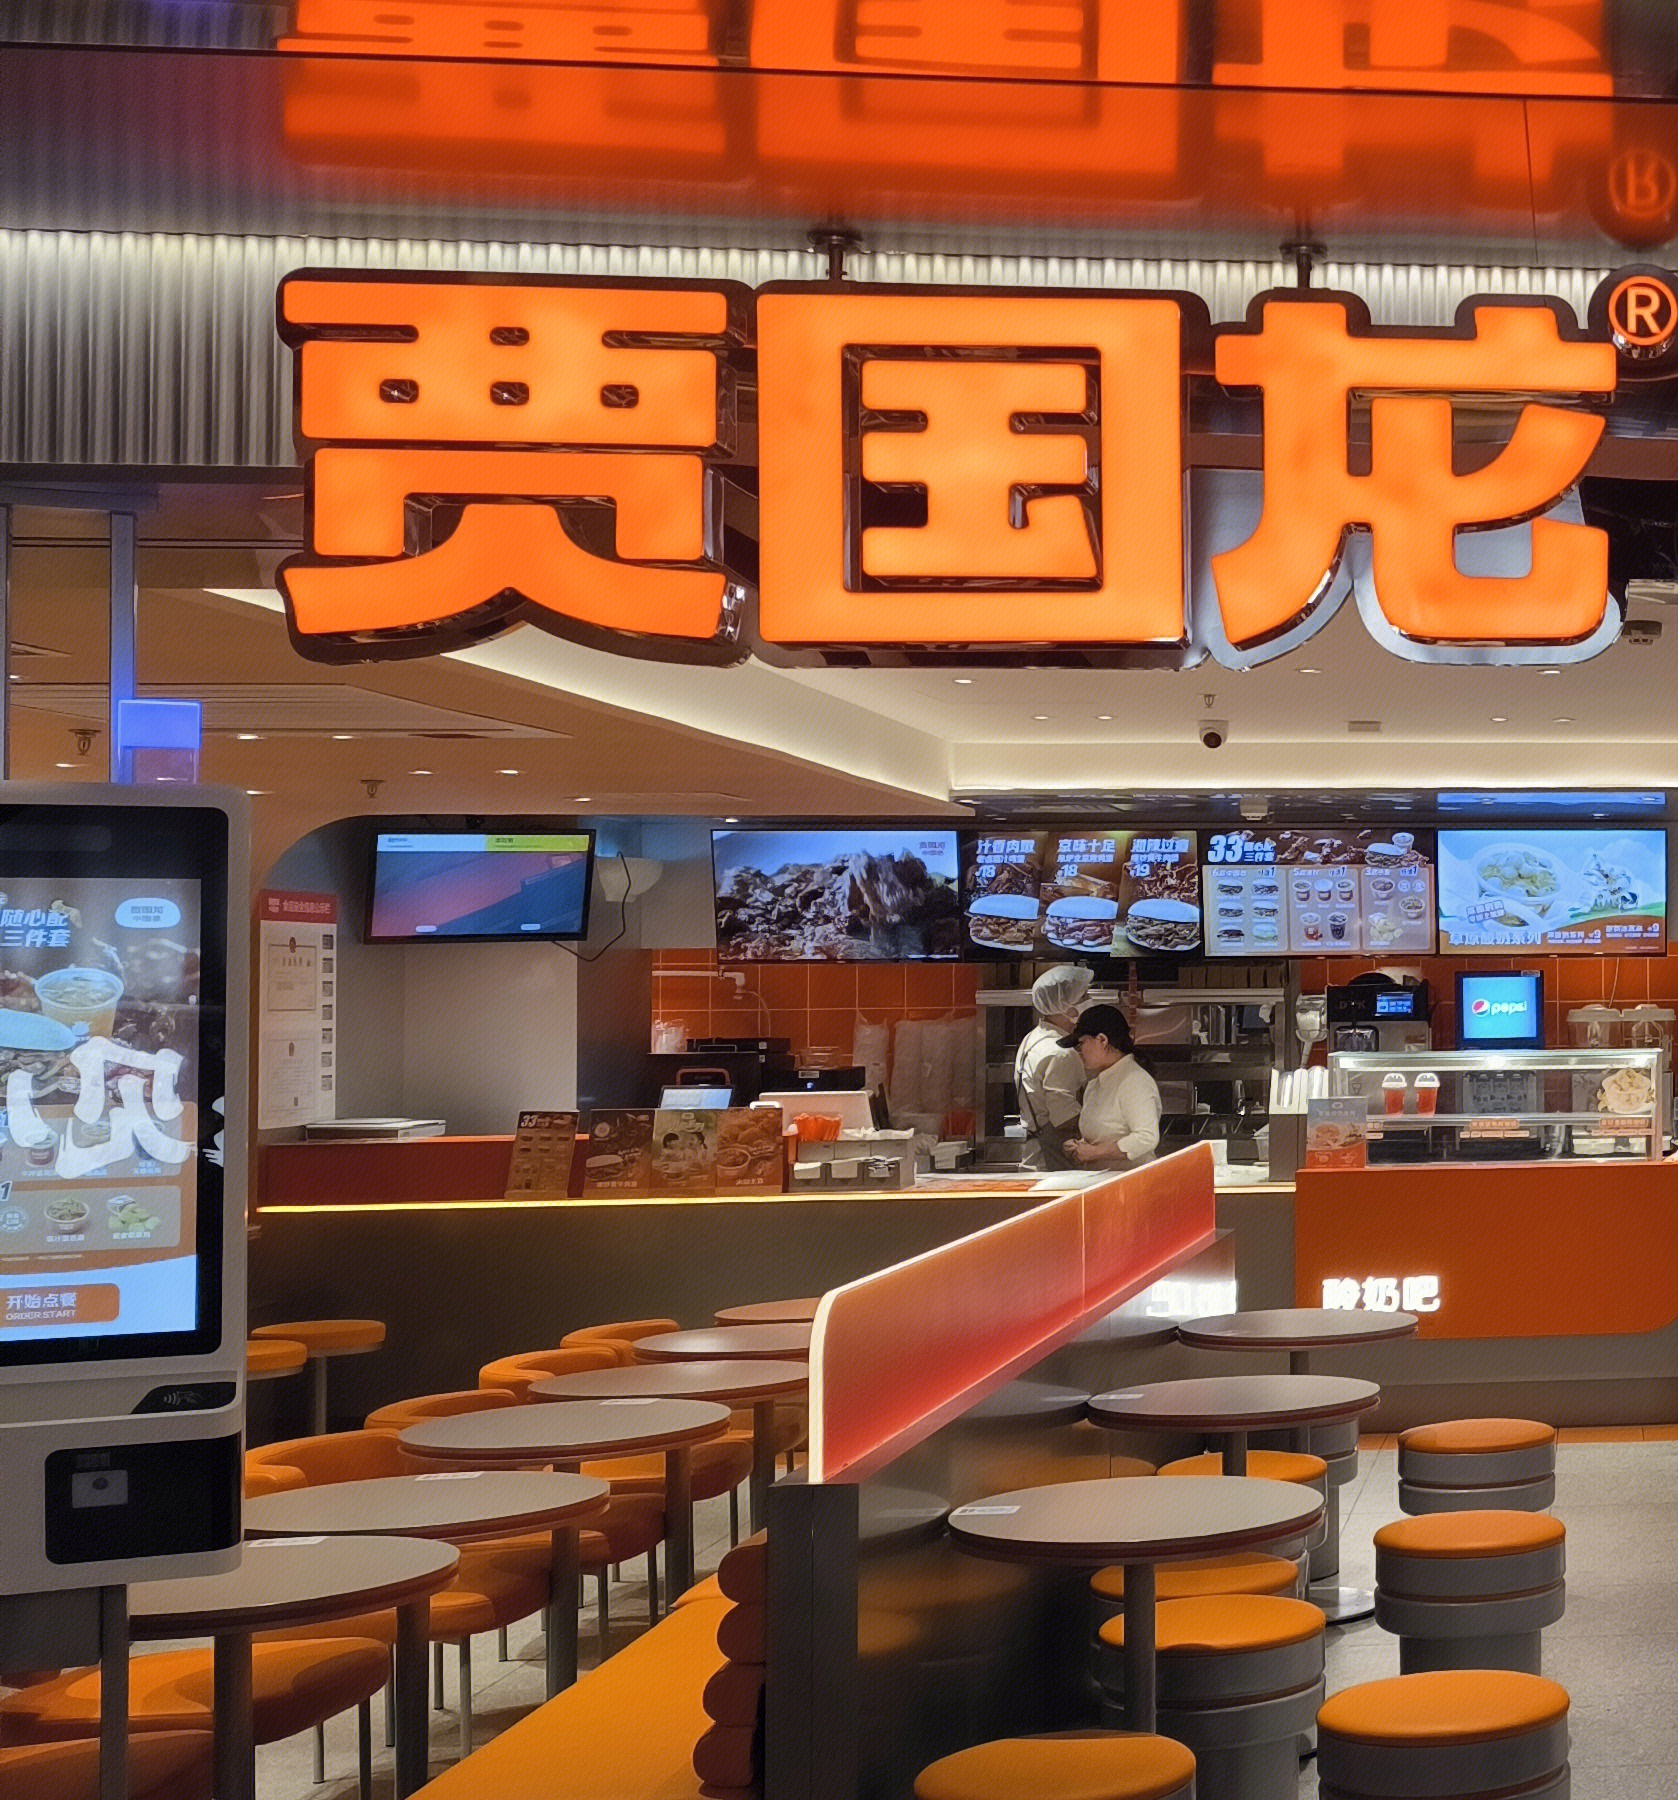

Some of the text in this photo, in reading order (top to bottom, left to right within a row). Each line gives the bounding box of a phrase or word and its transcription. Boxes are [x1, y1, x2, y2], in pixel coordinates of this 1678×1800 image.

[282, 279, 1617, 645] 贾国龙
[1208, 834, 1243, 862] 33
[0, 908, 70, 928] 随心配
[0, 928, 71, 948] 三件套
[1491, 1000, 1527, 1016] pepsi
[6, 1292, 77, 1310] 开始点餐
[1322, 1275, 1440, 1312] 酸奶吧
